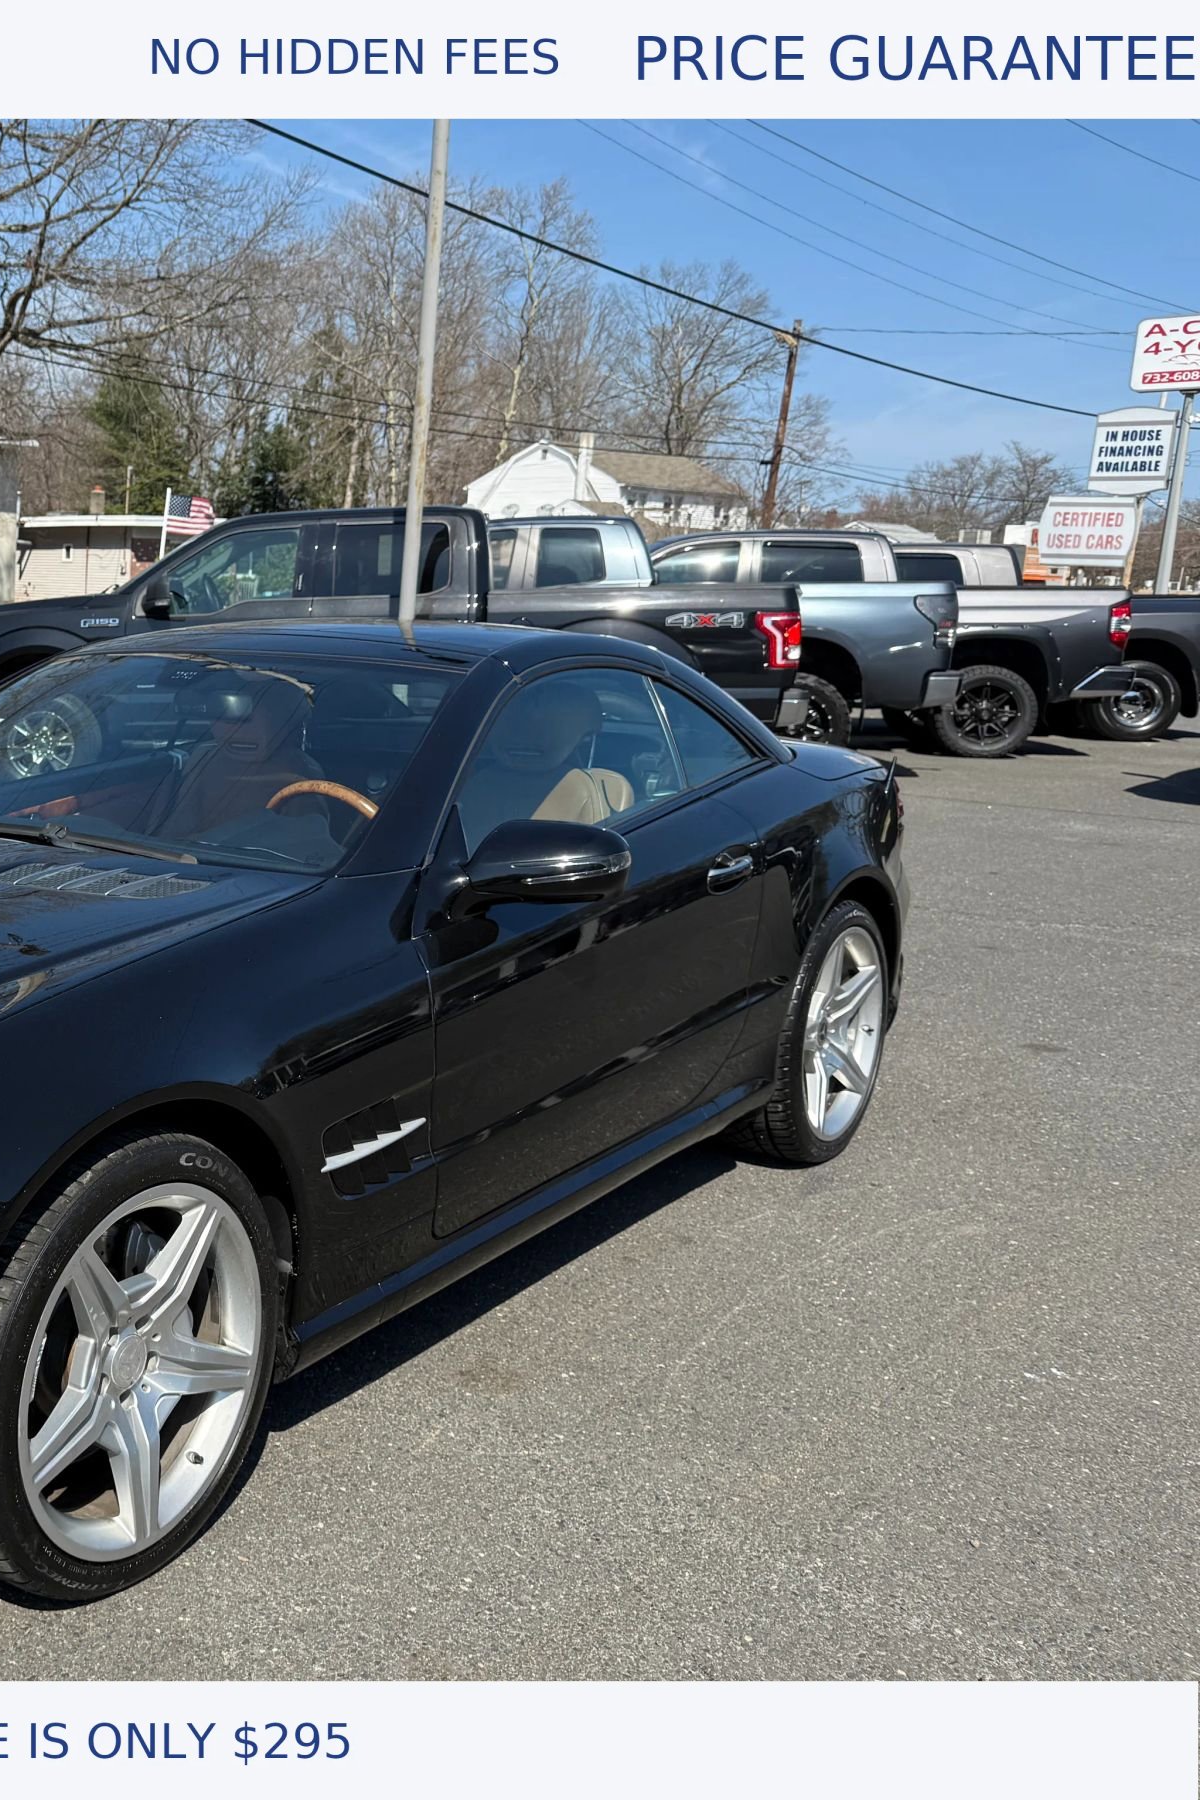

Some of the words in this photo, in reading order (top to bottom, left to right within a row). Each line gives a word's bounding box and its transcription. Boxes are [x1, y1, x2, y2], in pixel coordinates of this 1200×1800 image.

[1143, 339, 1200, 355] 4-Y
[1105, 430, 1119, 442] IN
[1121, 429, 1162, 442] HOUSE
[1098, 445, 1164, 457] FINANCING
[1096, 460, 1161, 472] AVAILABLE
[1053, 511, 1124, 527] CERTIFIED
[1047, 534, 1082, 549] USED
[1086, 534, 1124, 550] CARS
